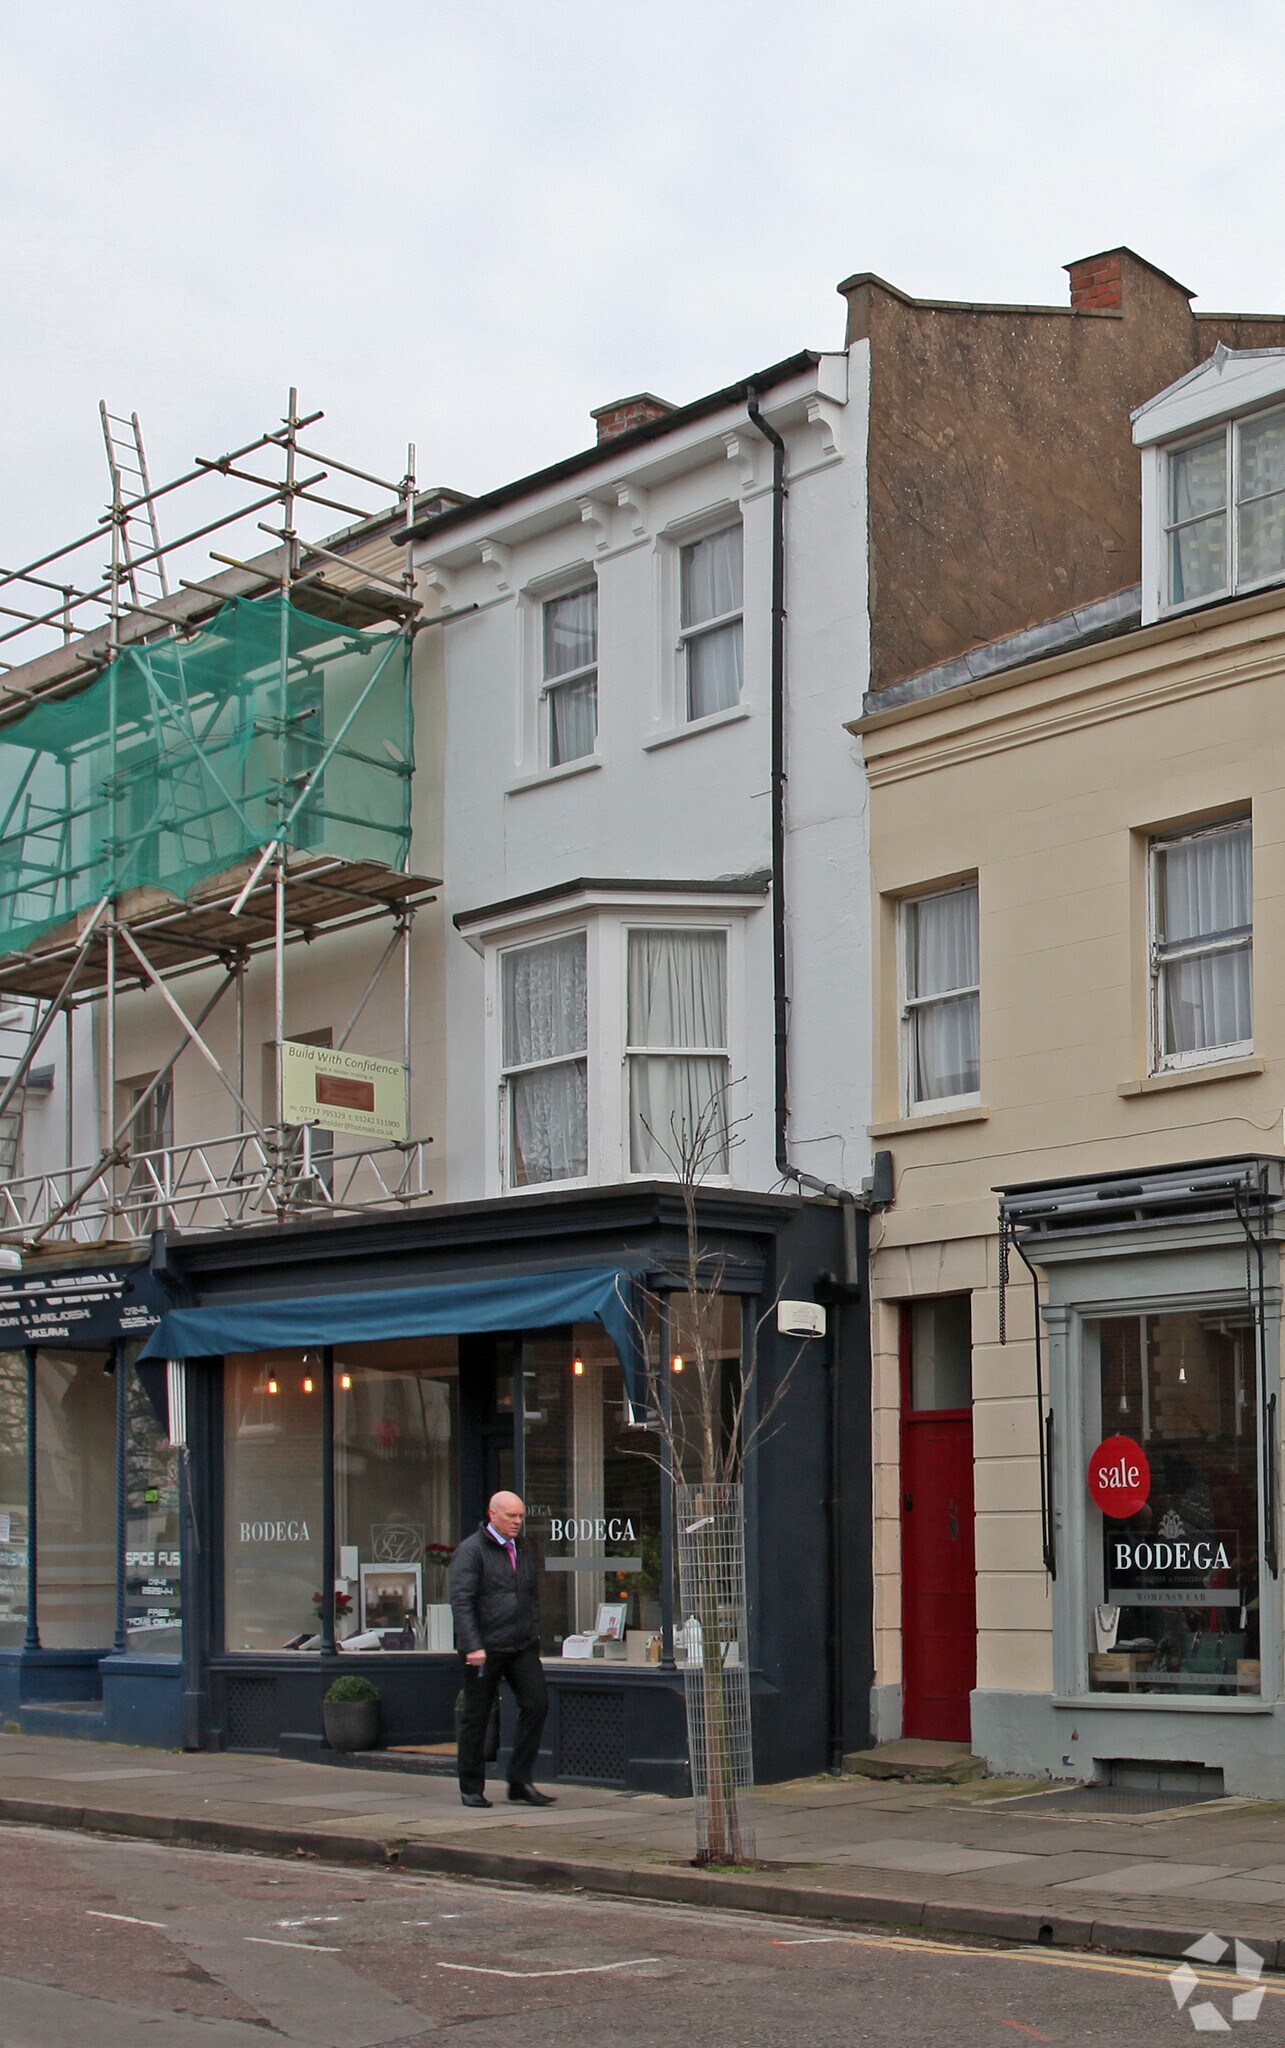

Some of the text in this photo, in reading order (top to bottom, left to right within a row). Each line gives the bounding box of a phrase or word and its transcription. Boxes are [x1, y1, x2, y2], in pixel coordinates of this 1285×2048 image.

[288, 1046, 400, 1076] Build With Confidence
[299, 1105, 320, 1116] 07717
[322, 1109, 346, 1119] 795329
[355, 1115, 376, 1125] 01242
[25, 1327, 70, 1339] TAKEAWAY
[1098, 1457, 1140, 1489] sale
[239, 1521, 311, 1542] BODEGA
[549, 1518, 637, 1541] BODEGA
[125, 1551, 155, 1567] SPICE
[1114, 1542, 1232, 1570] BODEGA
[1136, 1592, 1206, 1601] WOMENSWEAR
[147, 1608, 170, 1617] FREE
